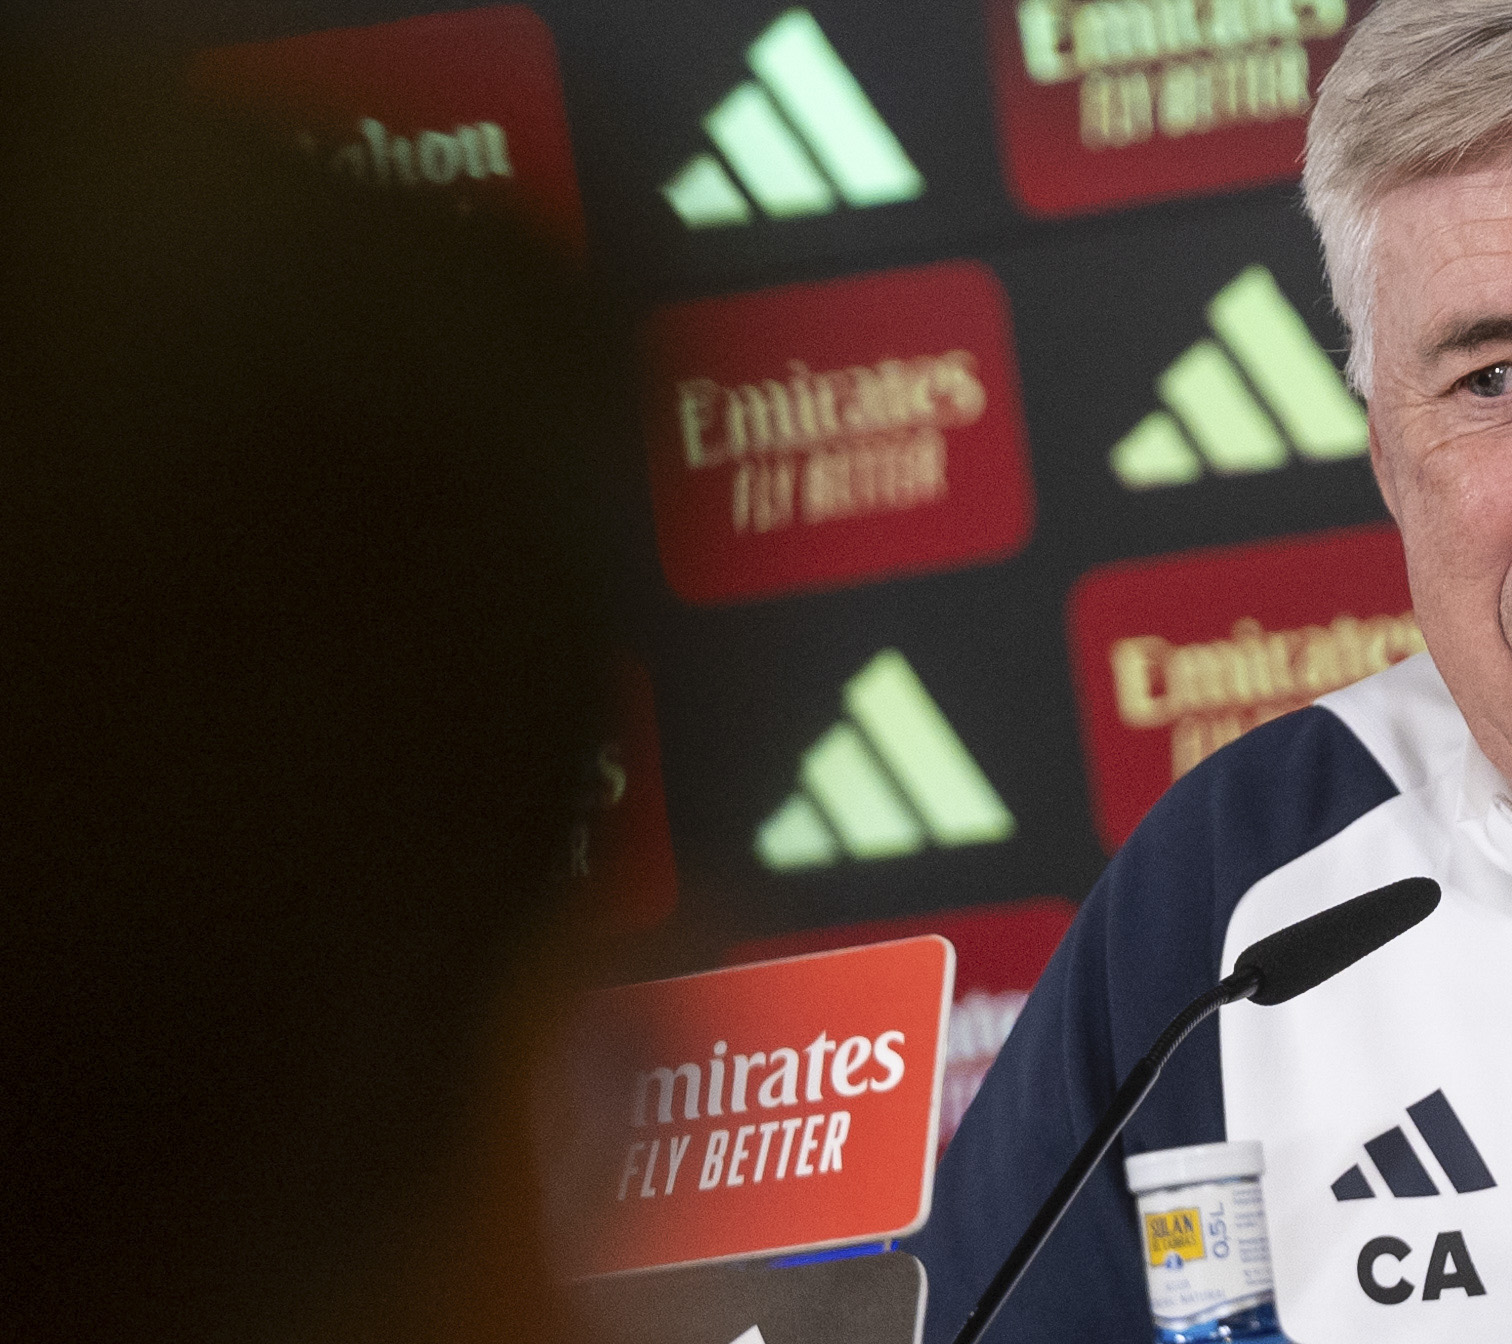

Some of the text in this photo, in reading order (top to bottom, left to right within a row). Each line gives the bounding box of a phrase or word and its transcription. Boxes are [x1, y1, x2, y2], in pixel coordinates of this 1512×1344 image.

[633, 1029, 906, 1128] mirates
[616, 1110, 852, 1202] FLY BETTER
[1356, 1230, 1487, 1306] CA
